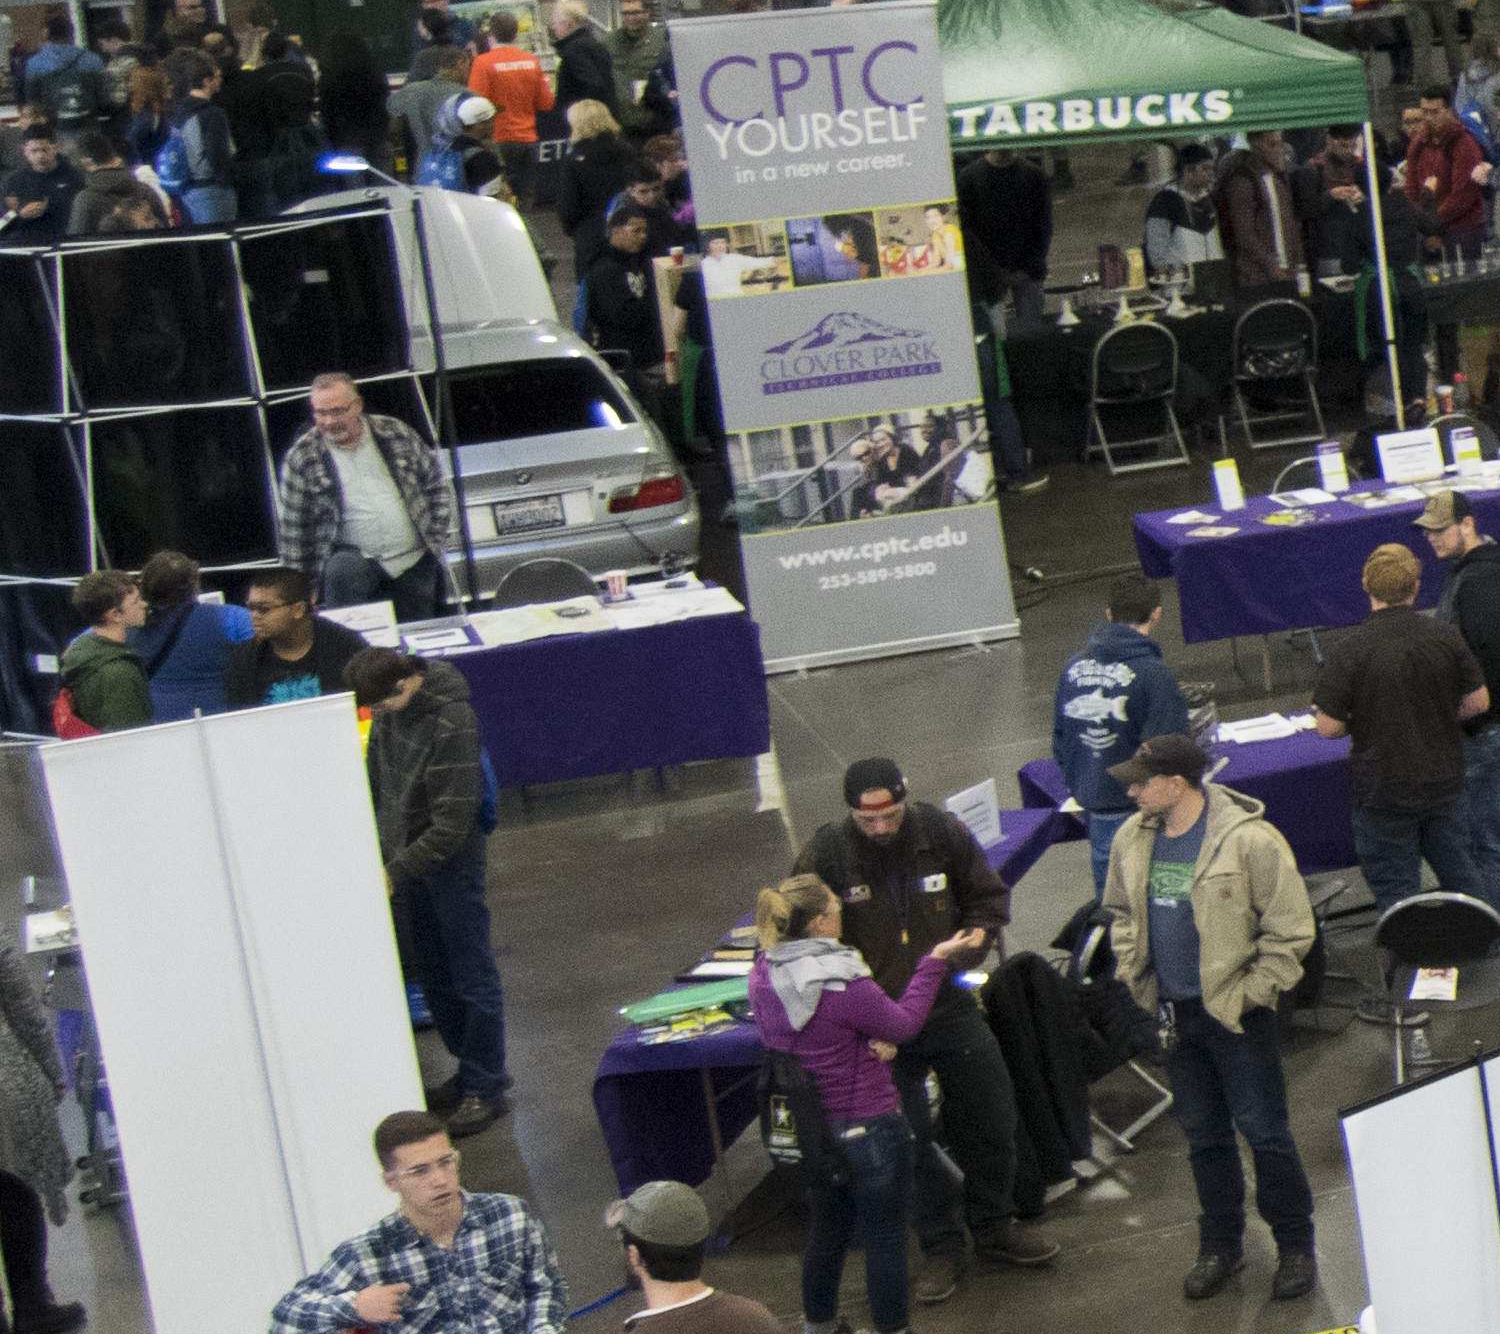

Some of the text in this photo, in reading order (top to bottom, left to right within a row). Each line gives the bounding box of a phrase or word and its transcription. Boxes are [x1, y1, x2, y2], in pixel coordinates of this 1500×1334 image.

[700, 40, 924, 127] CPTC
[705, 102, 928, 161] YOURSELF
[951, 88, 1235, 138] TARBUCKS
[735, 151, 913, 184] in a new career.
[760, 340, 941, 381] CLOVER PARK
[779, 526, 968, 570] www.cptc.edu
[818, 561, 937, 590] 253-589-5800
